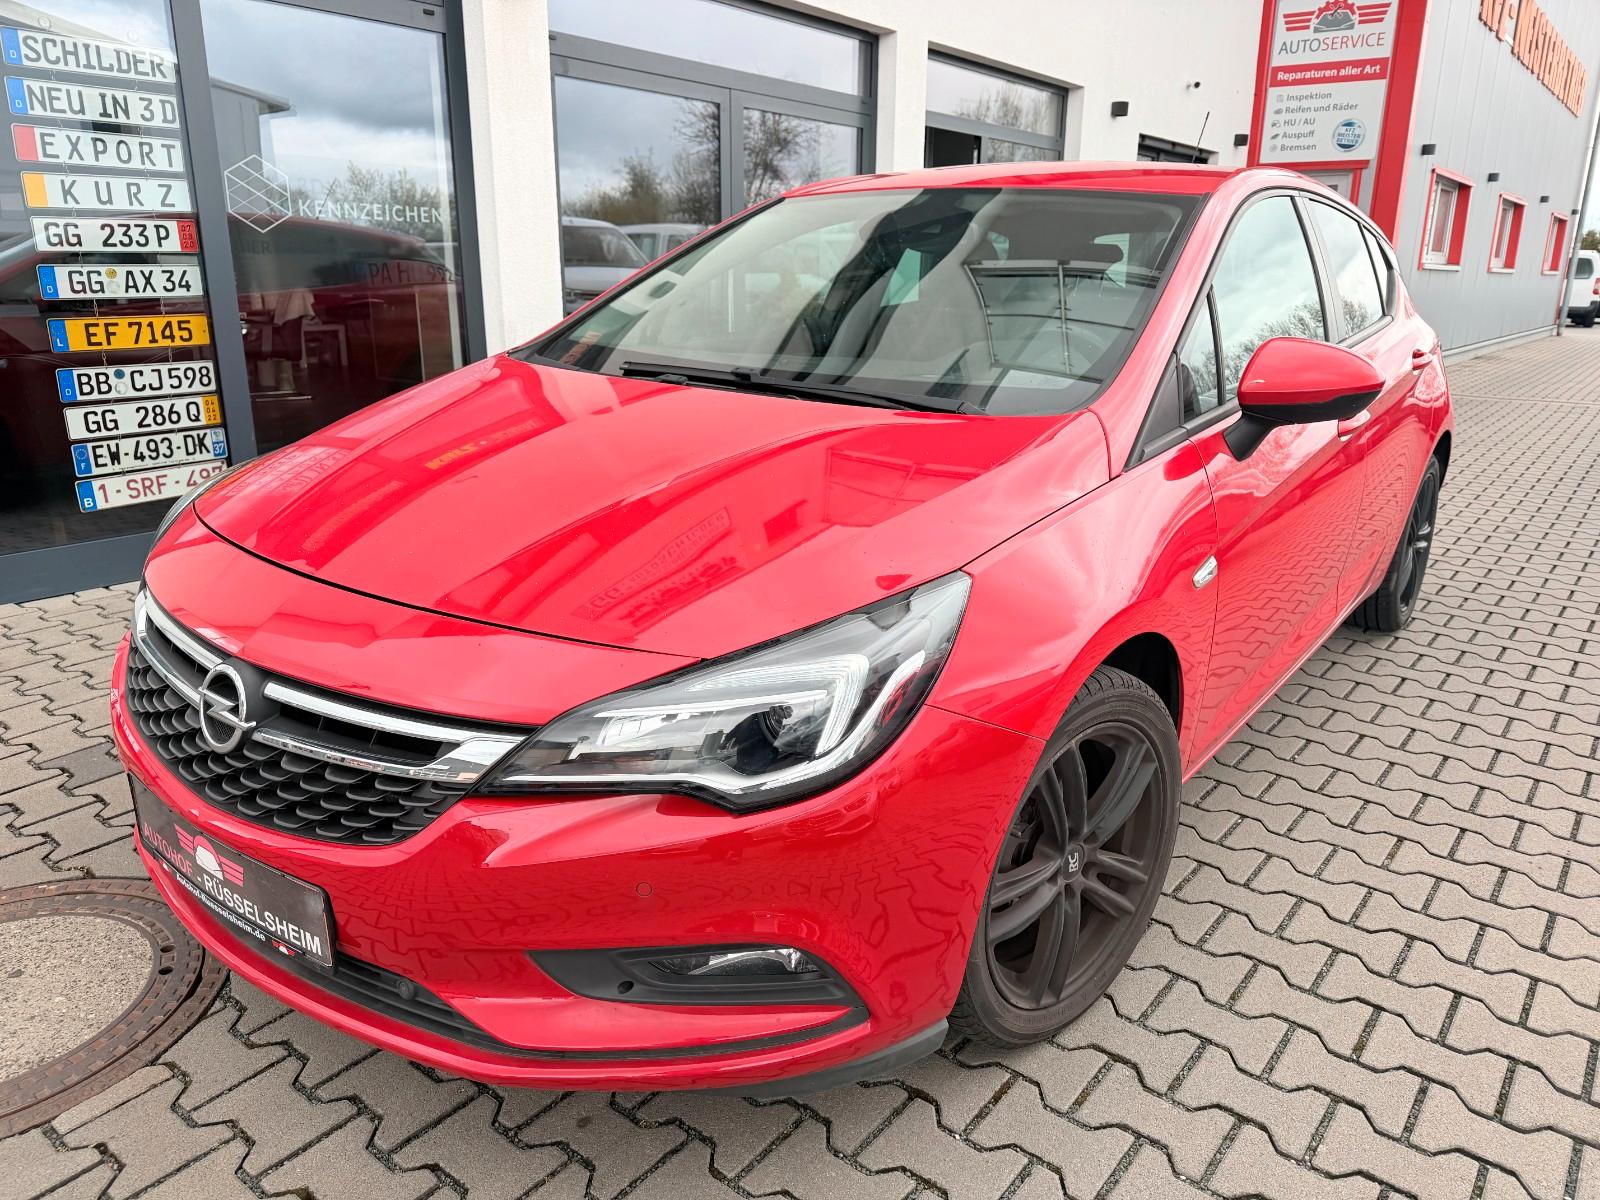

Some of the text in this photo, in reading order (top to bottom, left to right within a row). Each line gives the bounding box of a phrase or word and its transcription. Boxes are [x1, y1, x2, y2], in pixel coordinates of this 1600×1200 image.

[1278, 31, 1386, 55] AUTOSERVICE
[22, 35, 168, 79] SCHILDER
[1277, 64, 1380, 82] Reparaturen aller Art
[26, 84, 177, 125] NEU IN 3D
[1286, 91, 1332, 102] Inspektion
[1285, 102, 1359, 114] Reifen und Räder
[1283, 118, 1296, 126] HU
[1303, 117, 1316, 126] AU
[1281, 130, 1315, 140] Auspuff
[39, 132, 176, 168] EXPORT
[1280, 143, 1317, 151] Bremsen
[60, 179, 176, 208] KURZ
[298, 199, 444, 223] KENNZEICHEN
[43, 221, 83, 248] GG
[46, 285, 54, 294] D
[67, 269, 192, 294] GG AX 34
[84, 319, 193, 346] EF 7145
[57, 338, 64, 347] L
[65, 387, 72, 396] D
[76, 371, 113, 397] BB
[83, 400, 202, 434] GG 286 Q
[206, 406, 216, 414] 04
[213, 442, 225, 455] 37
[80, 462, 86, 471] F
[84, 497, 94, 508] B
[143, 821, 193, 877] AUTOHOF
[202, 873, 322, 956] RÜSSELSHEIM
